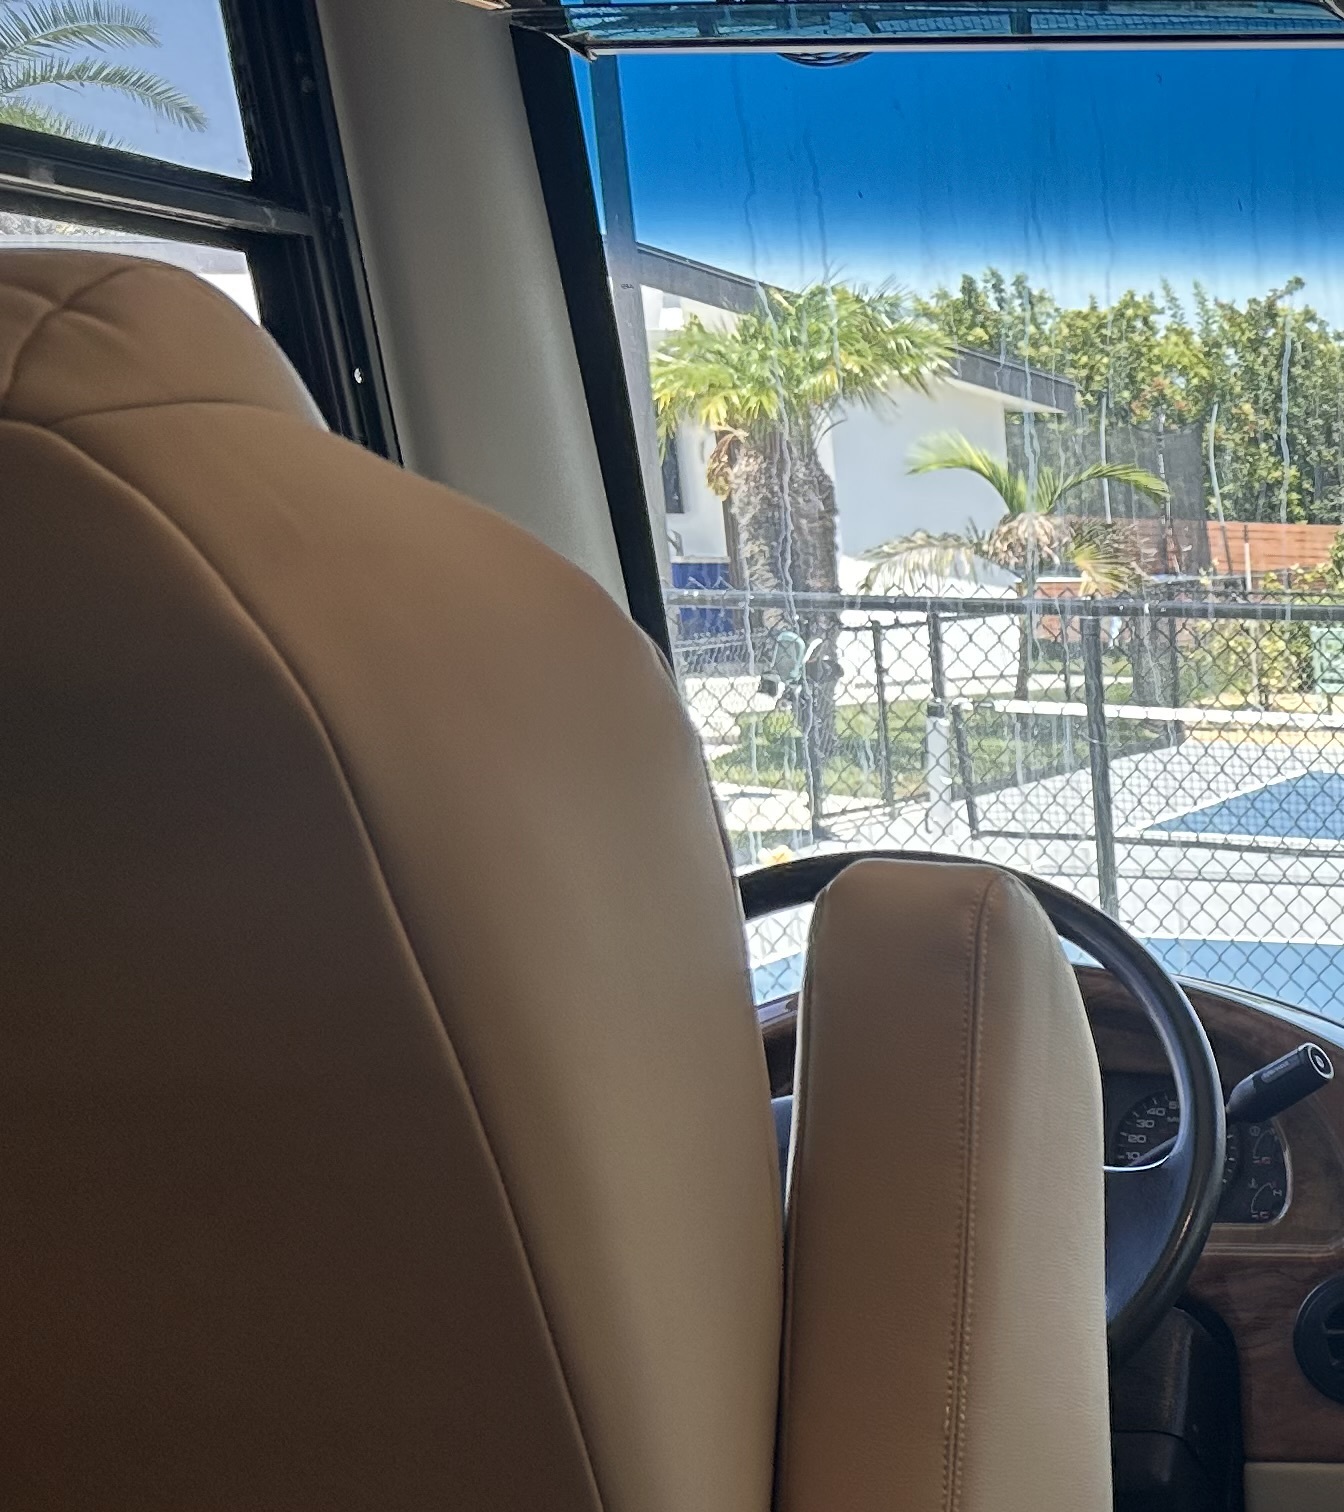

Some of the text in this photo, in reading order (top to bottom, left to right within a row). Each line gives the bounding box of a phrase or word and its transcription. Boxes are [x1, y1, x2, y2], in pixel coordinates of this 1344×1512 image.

[1146, 1107, 1166, 1117] 40
[1136, 1119, 1155, 1128] 30
[1127, 1134, 1147, 1143] 20
[1125, 1151, 1140, 1160] 10
